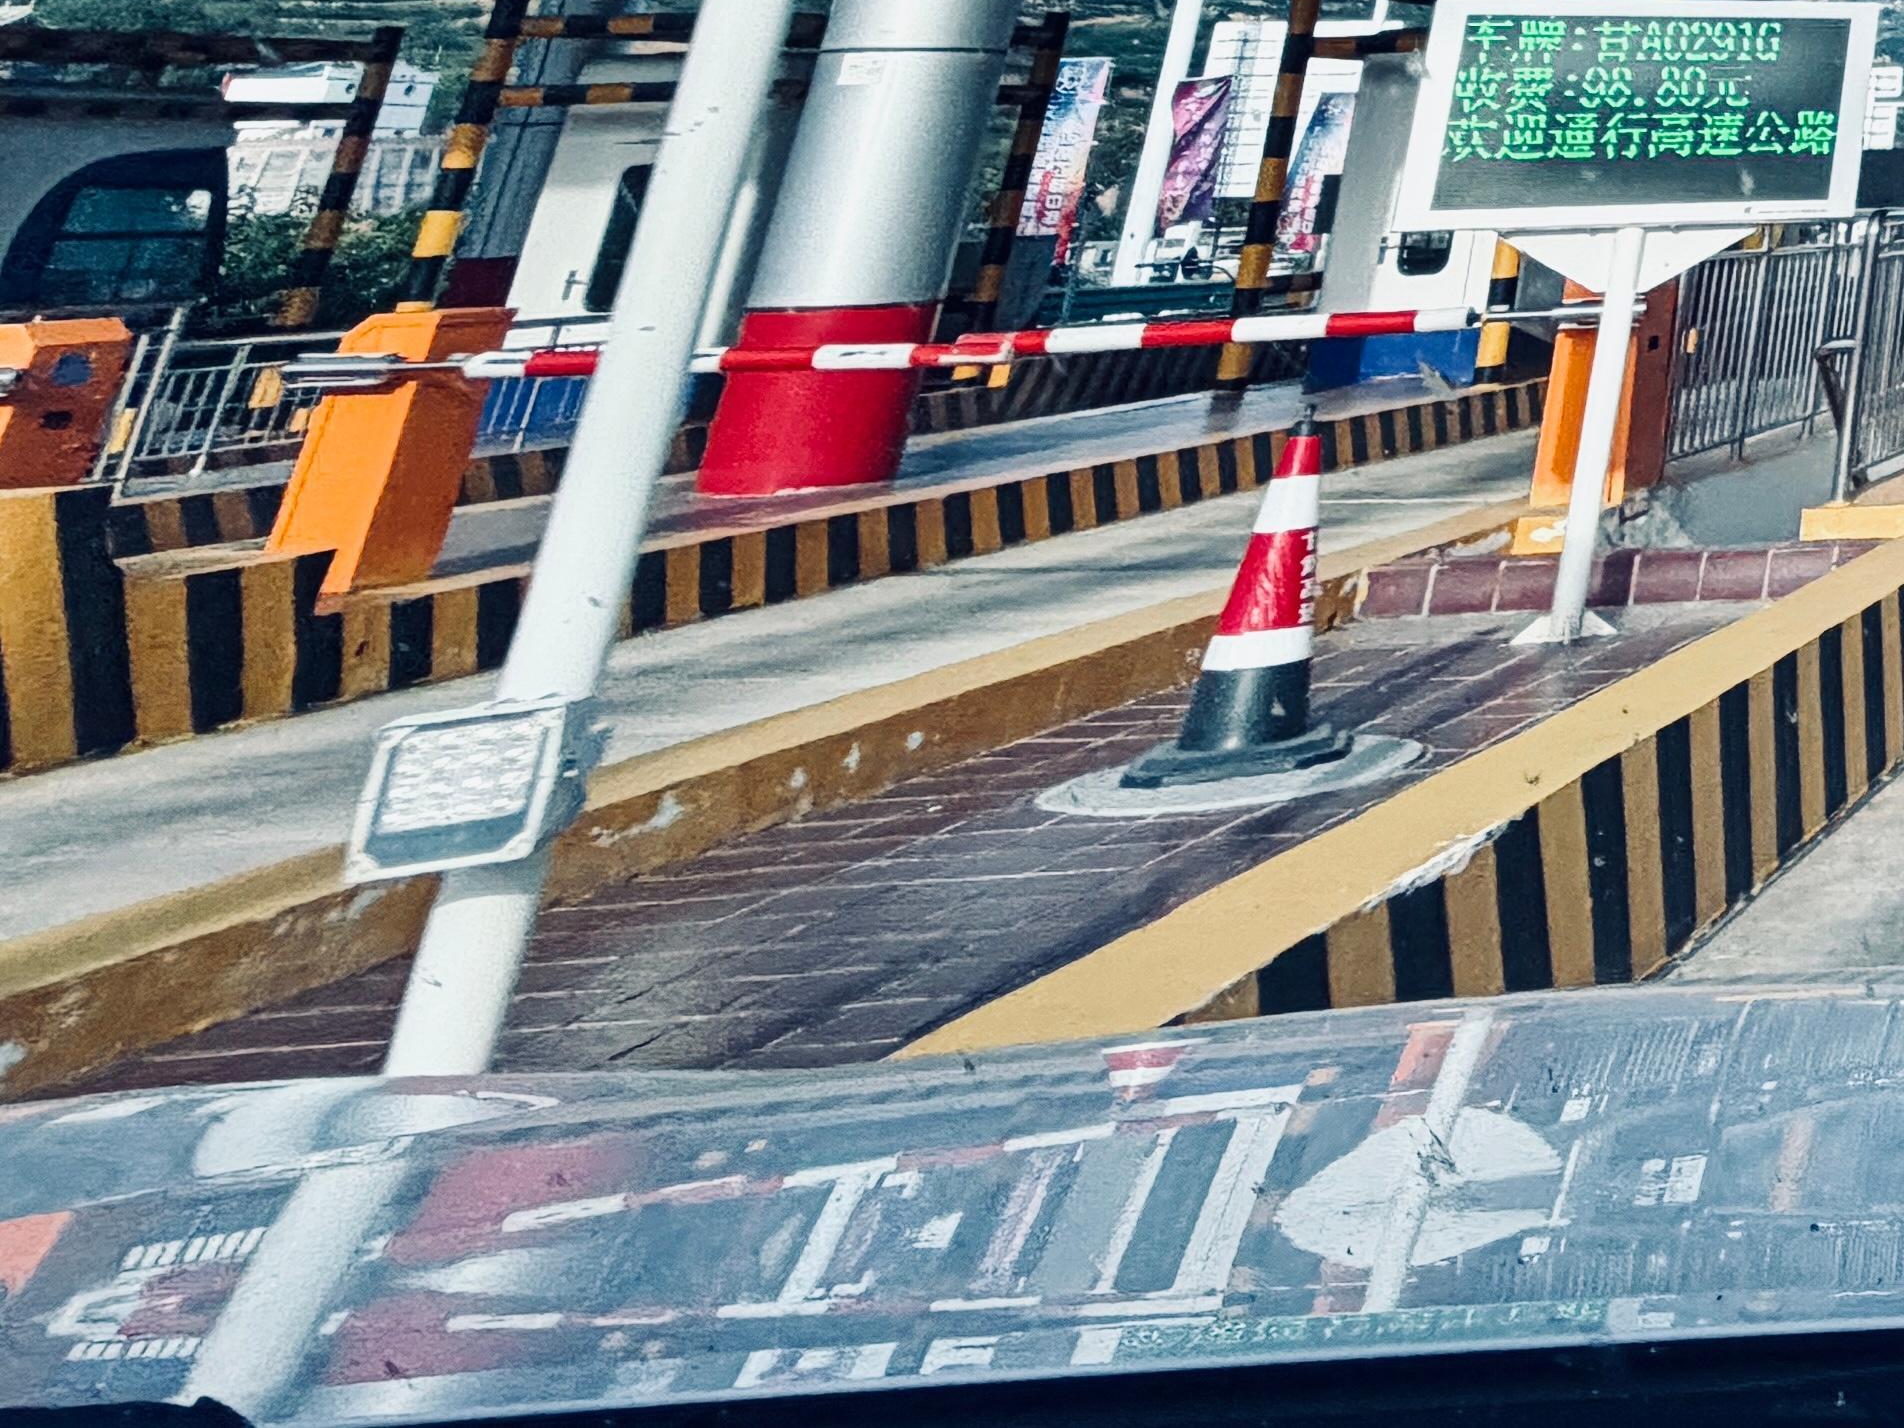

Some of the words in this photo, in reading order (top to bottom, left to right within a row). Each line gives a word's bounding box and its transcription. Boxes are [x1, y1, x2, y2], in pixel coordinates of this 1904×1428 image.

[1441, 109, 1839, 162] 欢迎通行高速公路
